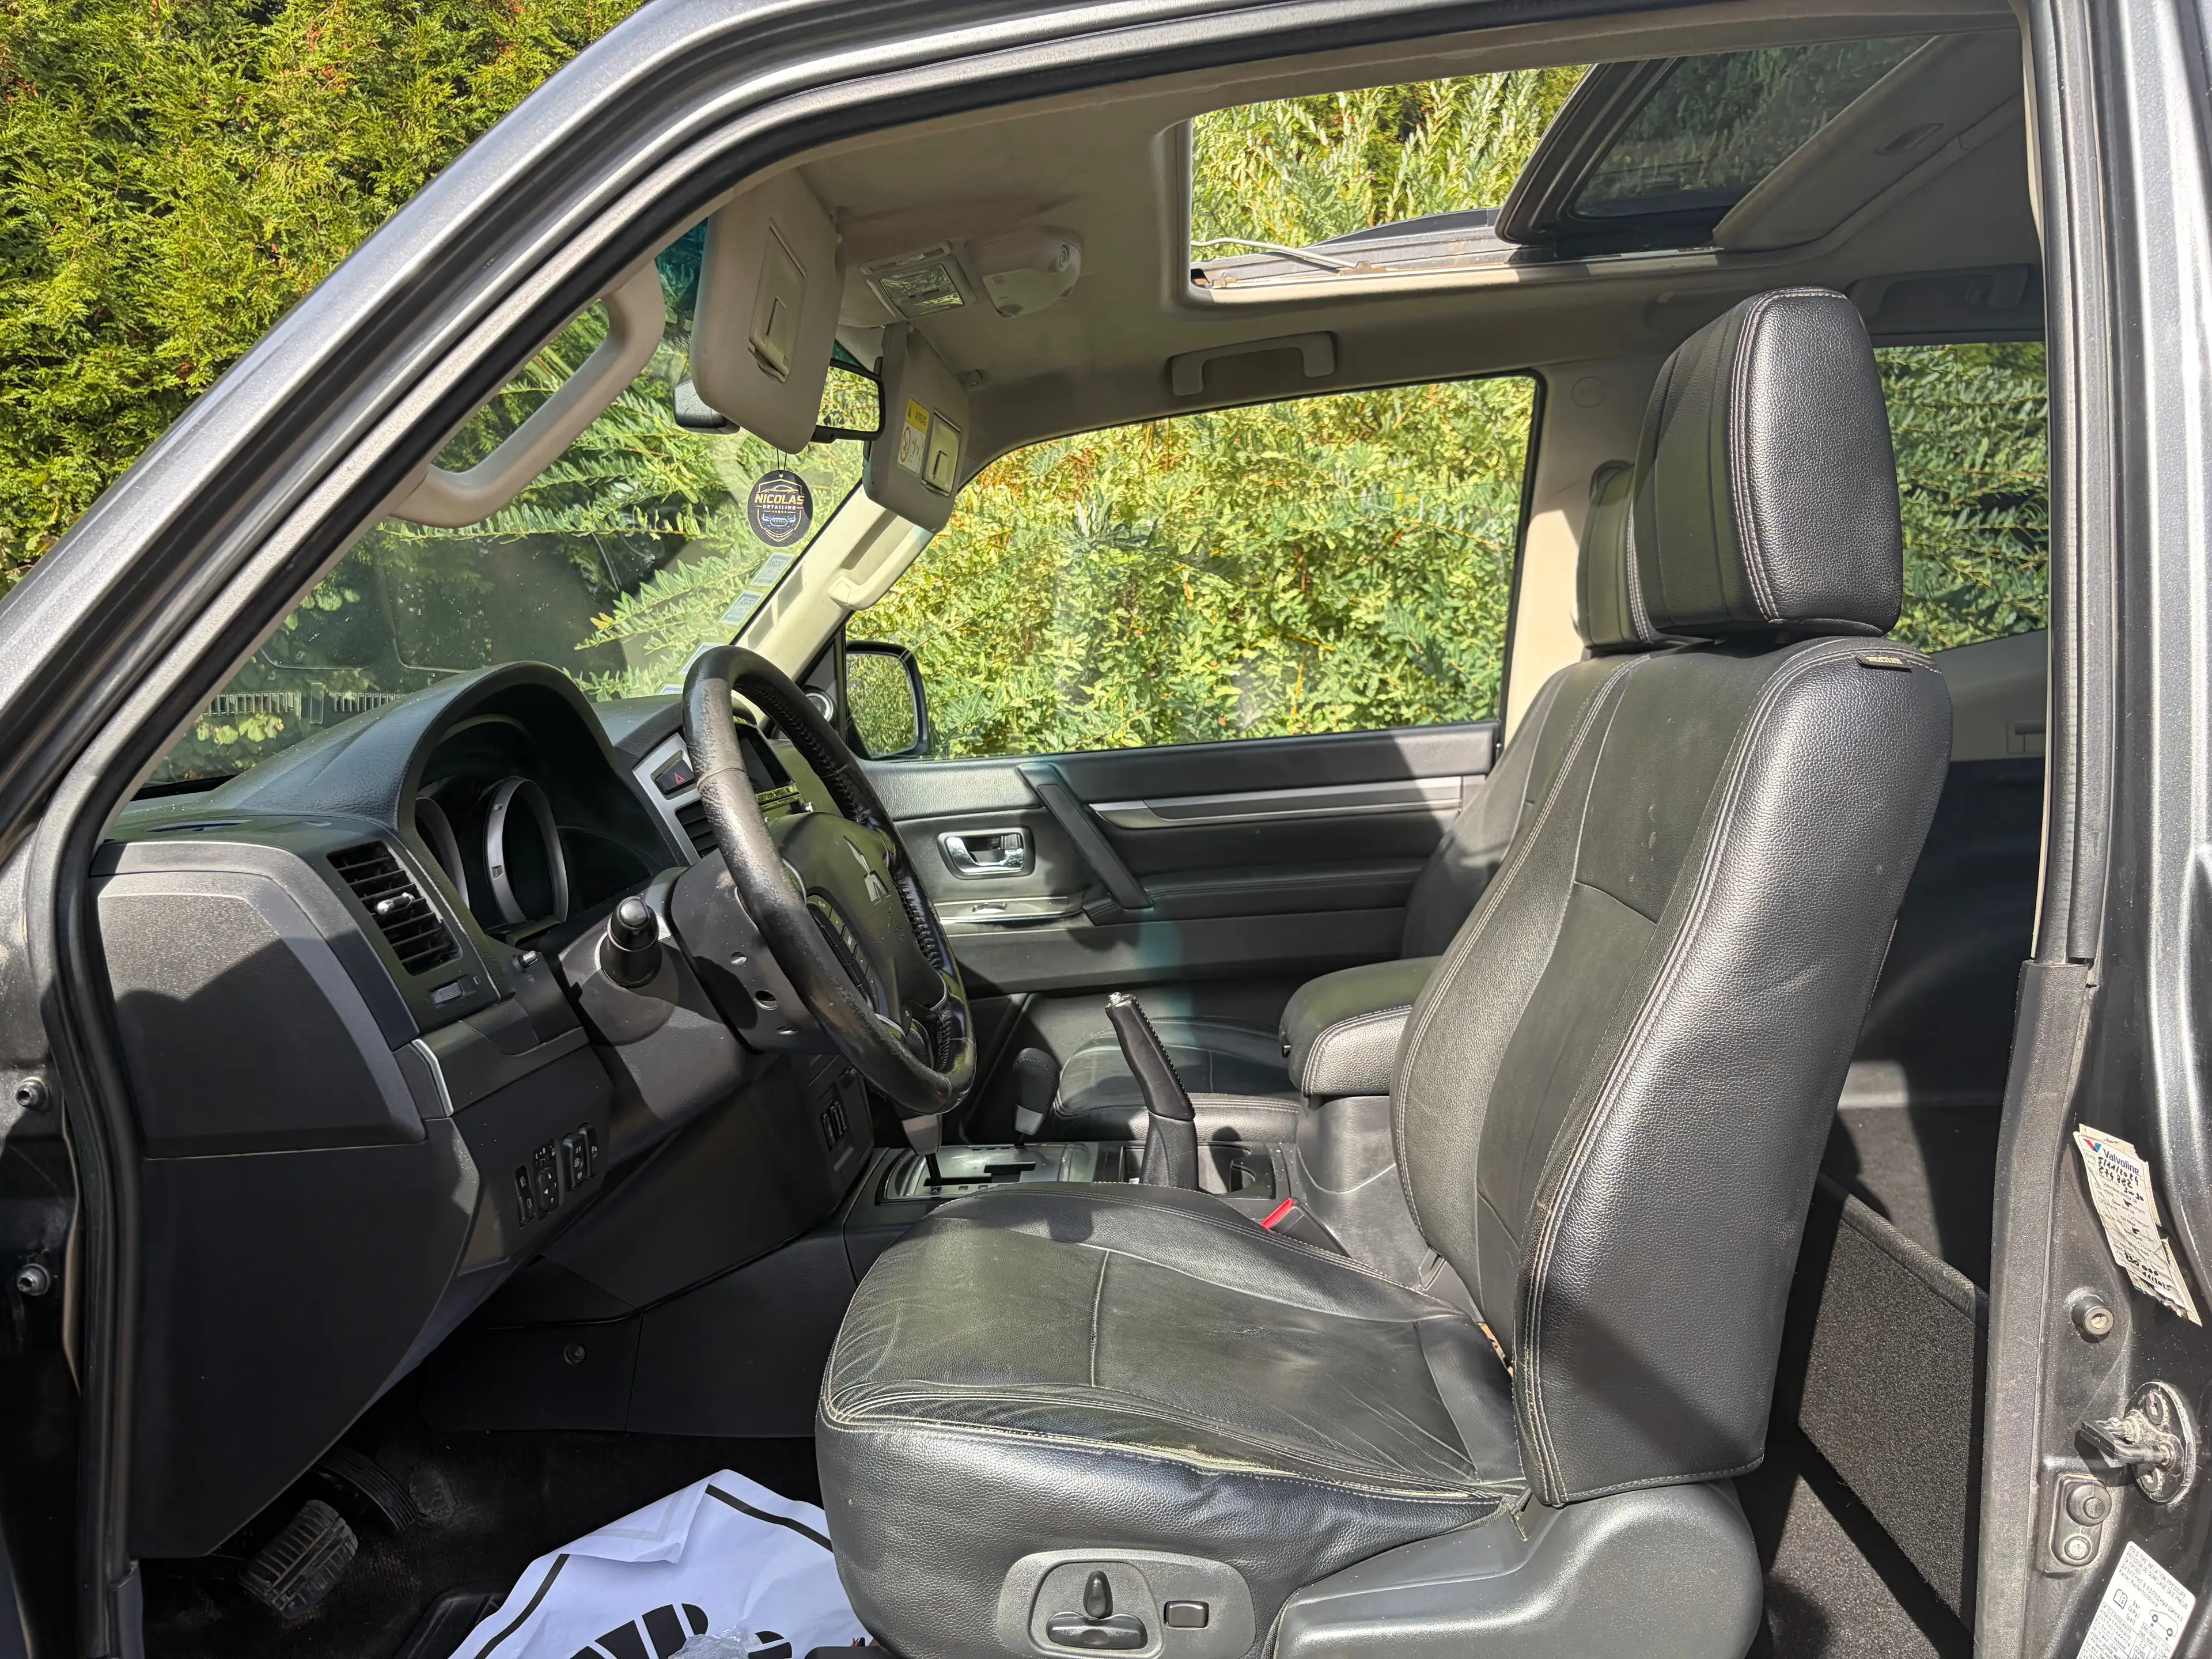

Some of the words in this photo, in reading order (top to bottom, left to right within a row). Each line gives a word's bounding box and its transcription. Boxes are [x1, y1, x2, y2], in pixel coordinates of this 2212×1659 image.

[754, 493, 805, 505] NICOLAS
[2103, 1148, 2139, 1175] Valvoline
[2126, 1550, 2143, 1569] PRESSION
[2142, 1565, 2148, 1573] DE
[2147, 1570, 2167, 1590] GONFLAGE
[2166, 1587, 2175, 1597] DES
[2174, 1594, 2188, 1609] PNEUS
[2128, 1545, 2139, 1557] COLD
[2139, 1554, 2147, 1565] TIRE
[2147, 1562, 2166, 1582] INFLATION
[2166, 1578, 2186, 1599] PRESSURE
[2132, 1600, 2140, 1609] bar
[2127, 1605, 2140, 1620] (kPa)
[2138, 1639, 2146, 1650] 2.2
